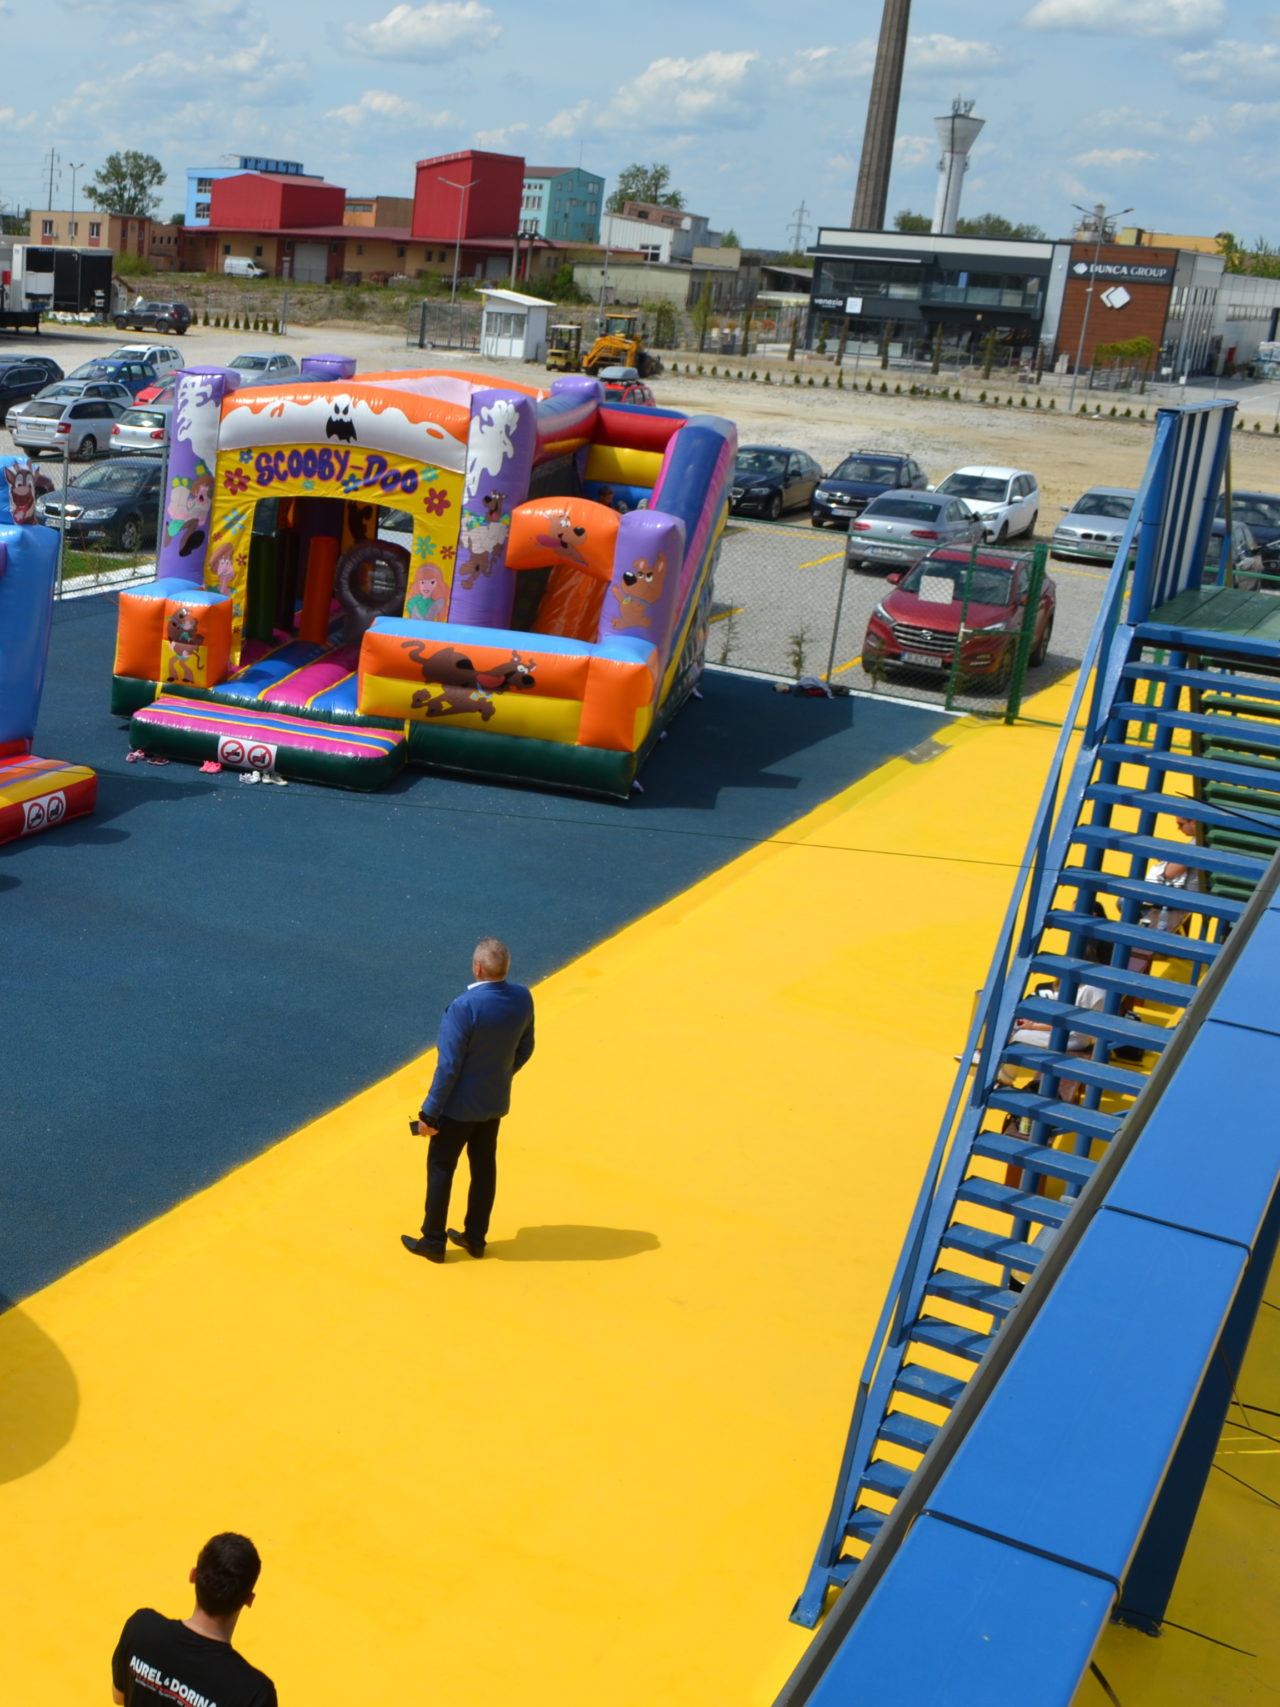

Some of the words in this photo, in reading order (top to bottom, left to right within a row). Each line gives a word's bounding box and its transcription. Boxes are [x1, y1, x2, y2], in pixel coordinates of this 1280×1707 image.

[1089, 263, 1128, 275] DUNCA
[1130, 265, 1168, 277] GROUP
[814, 297, 843, 307] venezia
[129, 1655, 162, 1686] AUREL
